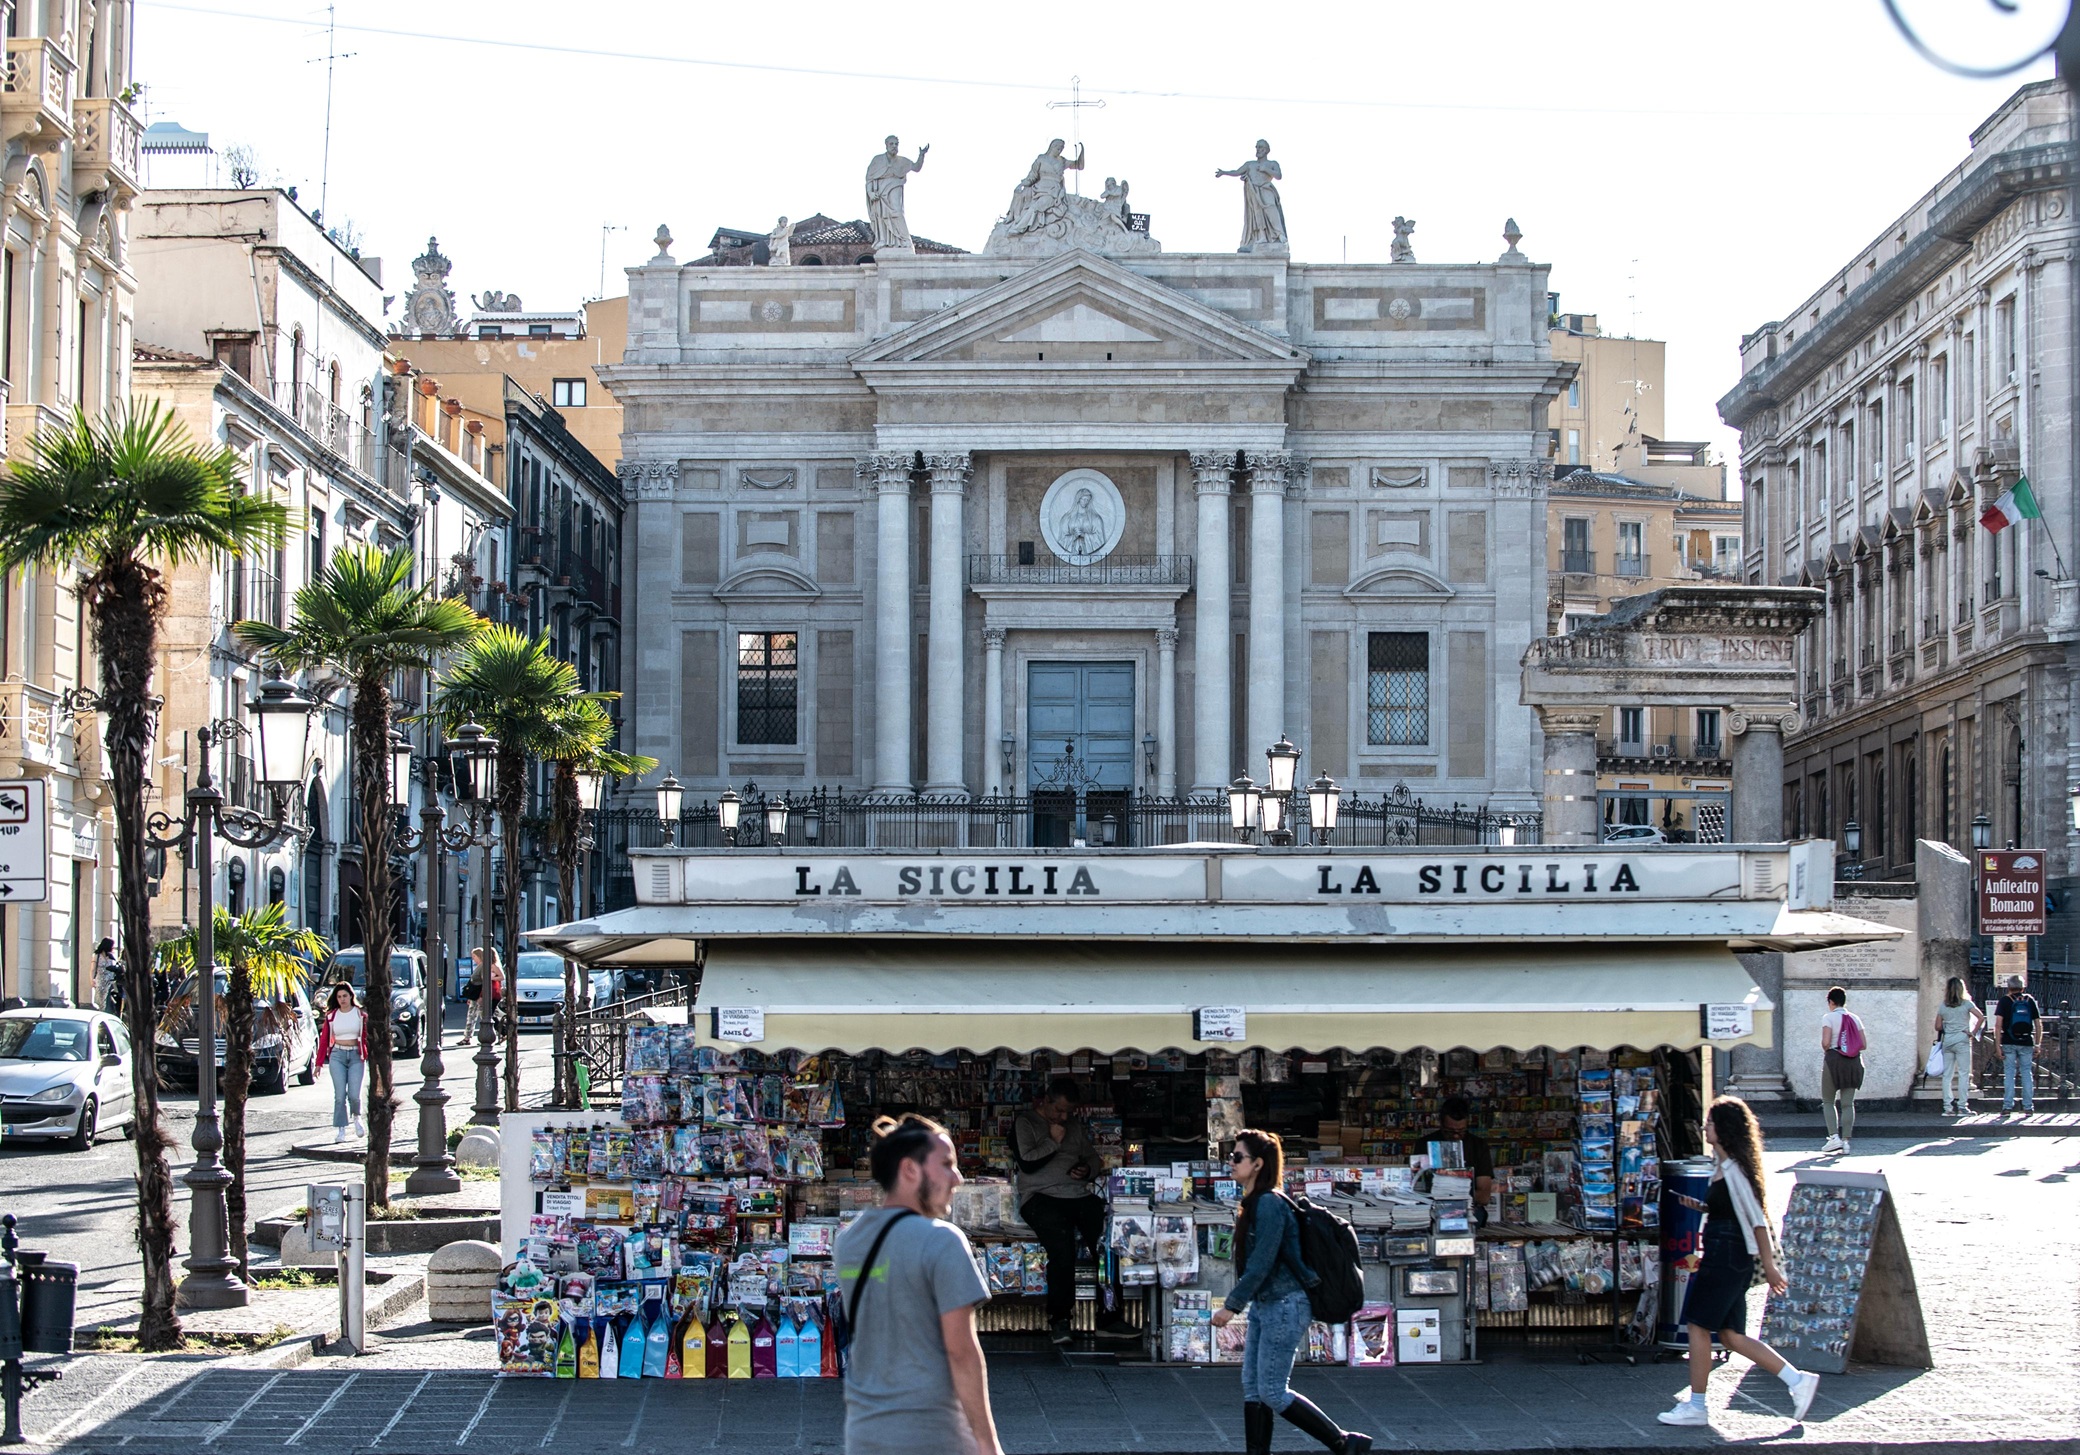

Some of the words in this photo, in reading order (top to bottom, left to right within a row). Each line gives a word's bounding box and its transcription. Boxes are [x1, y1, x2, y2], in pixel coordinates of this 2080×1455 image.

[796, 866, 862, 895] LA
[898, 865, 1100, 895] SICILIA
[1318, 865, 1381, 894] LA
[1418, 864, 1640, 894] SICILIA
[1985, 878, 2039, 894] Anfiteatro
[1990, 897, 2034, 912] Romano
